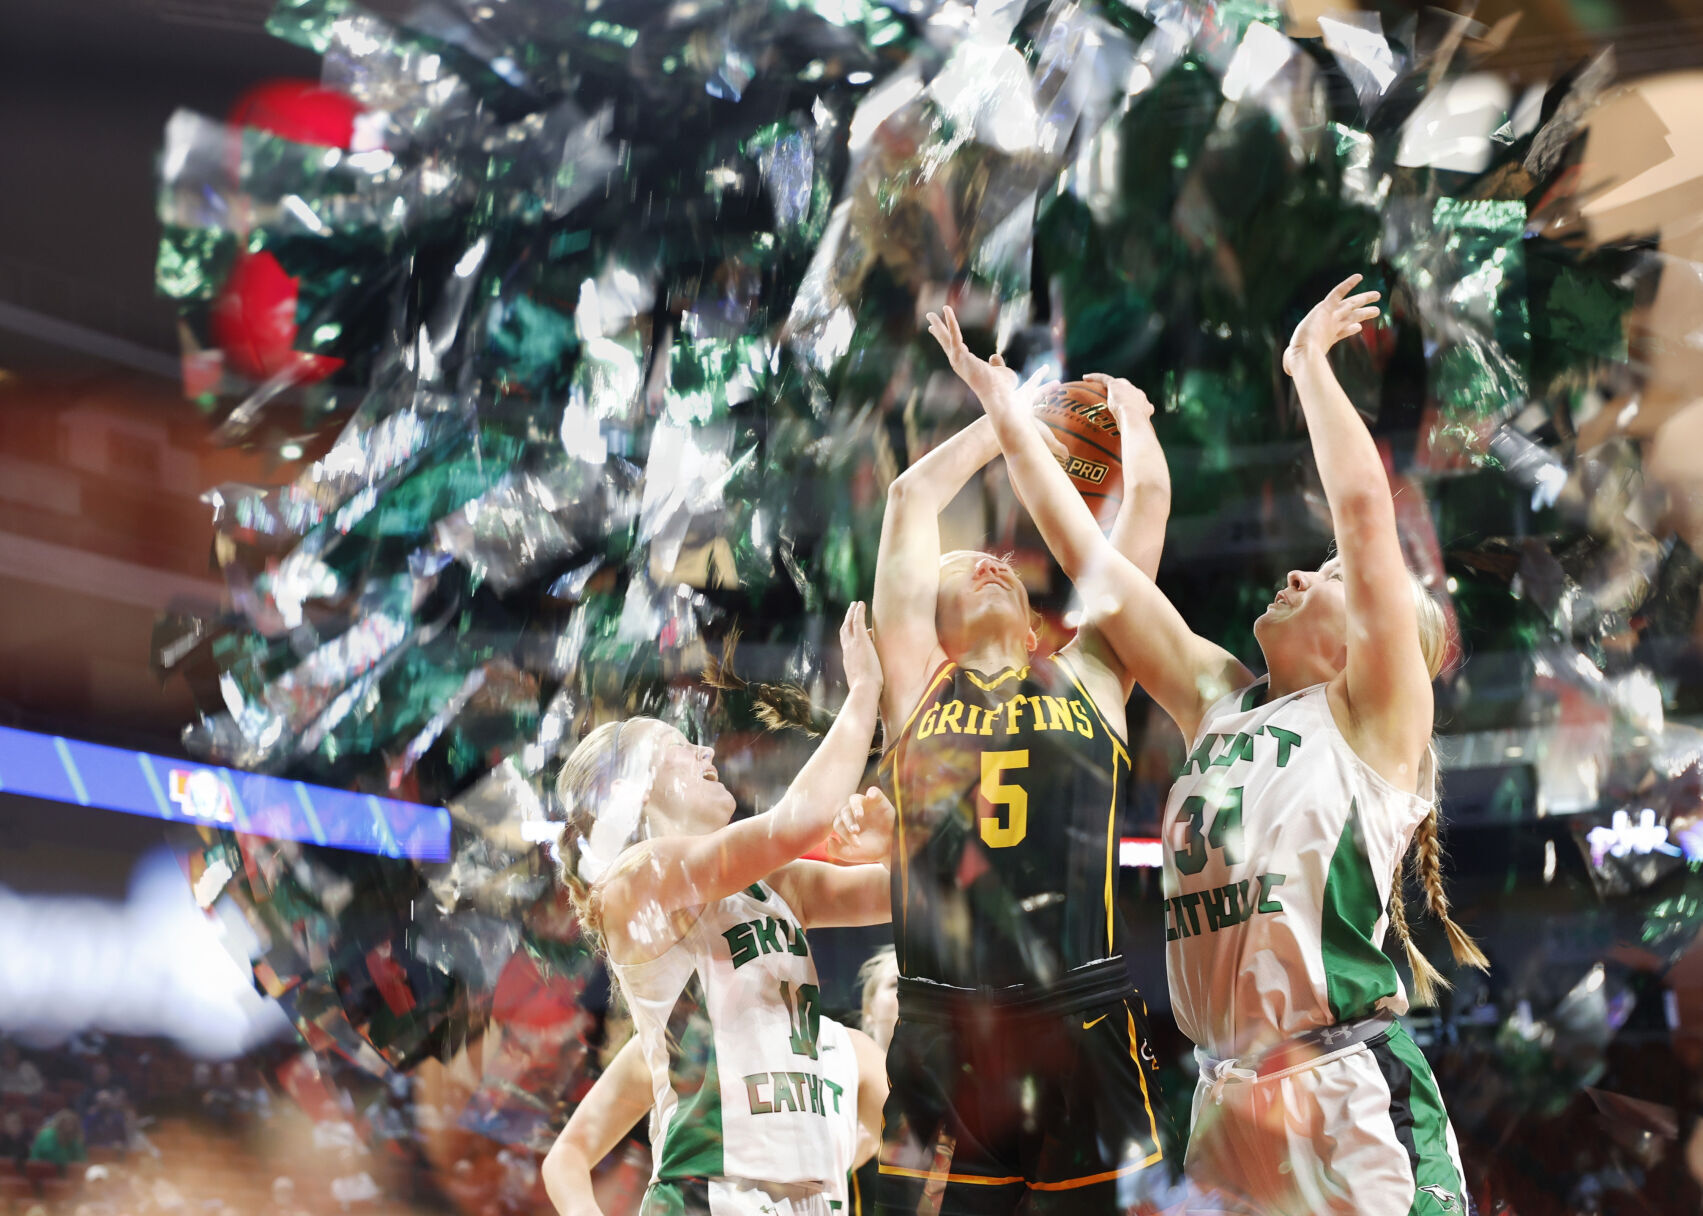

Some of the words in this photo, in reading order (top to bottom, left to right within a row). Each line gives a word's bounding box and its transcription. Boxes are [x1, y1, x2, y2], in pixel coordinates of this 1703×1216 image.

[1068, 459, 1105, 481] PRO
[917, 693, 1094, 740] GRIFFINS
[980, 749, 1029, 848] 5
[1174, 785, 1244, 876] 34
